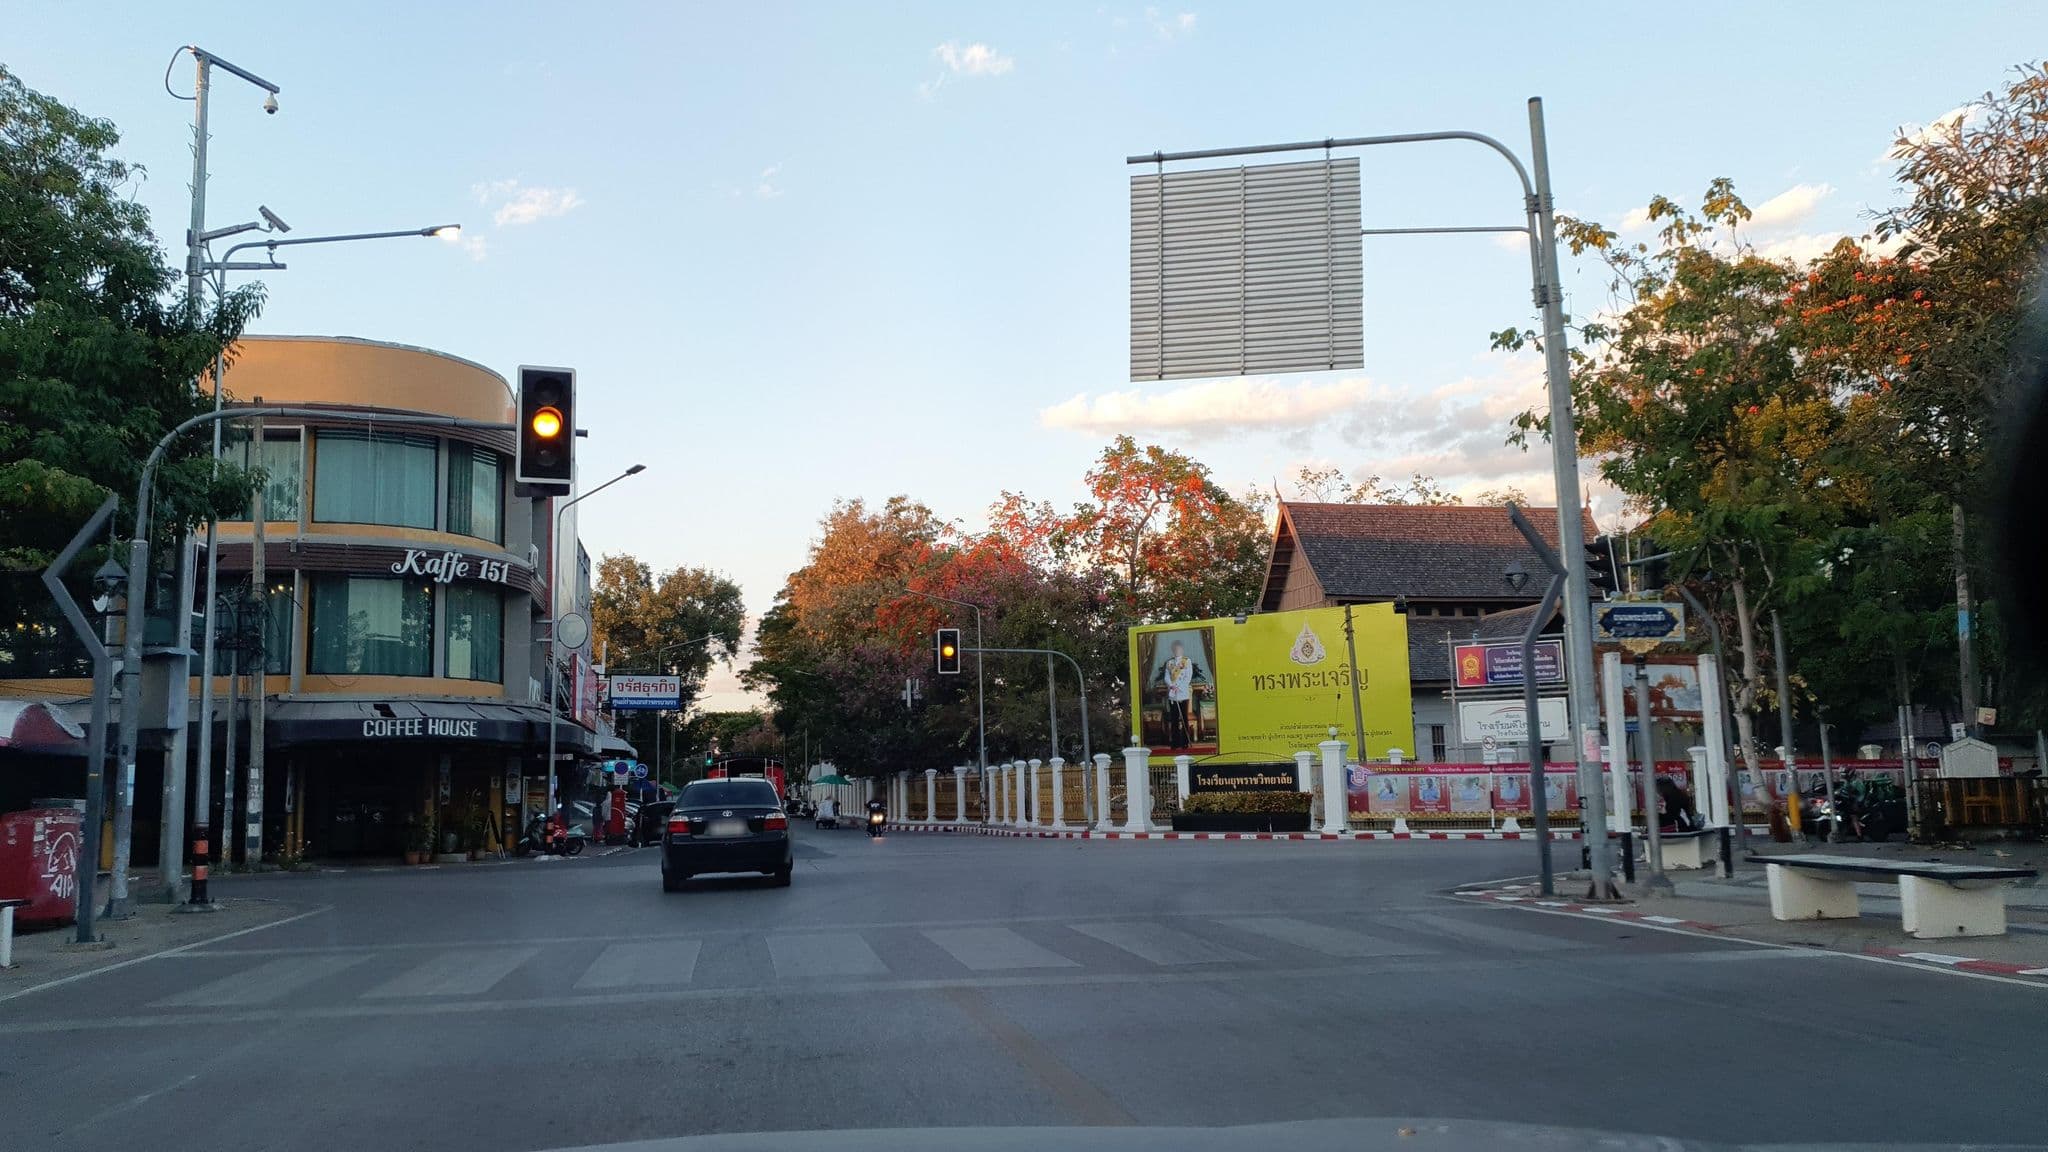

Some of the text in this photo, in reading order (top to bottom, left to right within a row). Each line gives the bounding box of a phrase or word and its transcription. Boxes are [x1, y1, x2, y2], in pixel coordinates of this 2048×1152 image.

[391, 550, 512, 584] Kaffe 151
[616, 677, 676, 697] จรัสธุรกิจ
[363, 719, 477, 737] COFFEE HOUSE
[1196, 772, 1293, 789] โรงเรียนยุพราชวิทยาลัย
